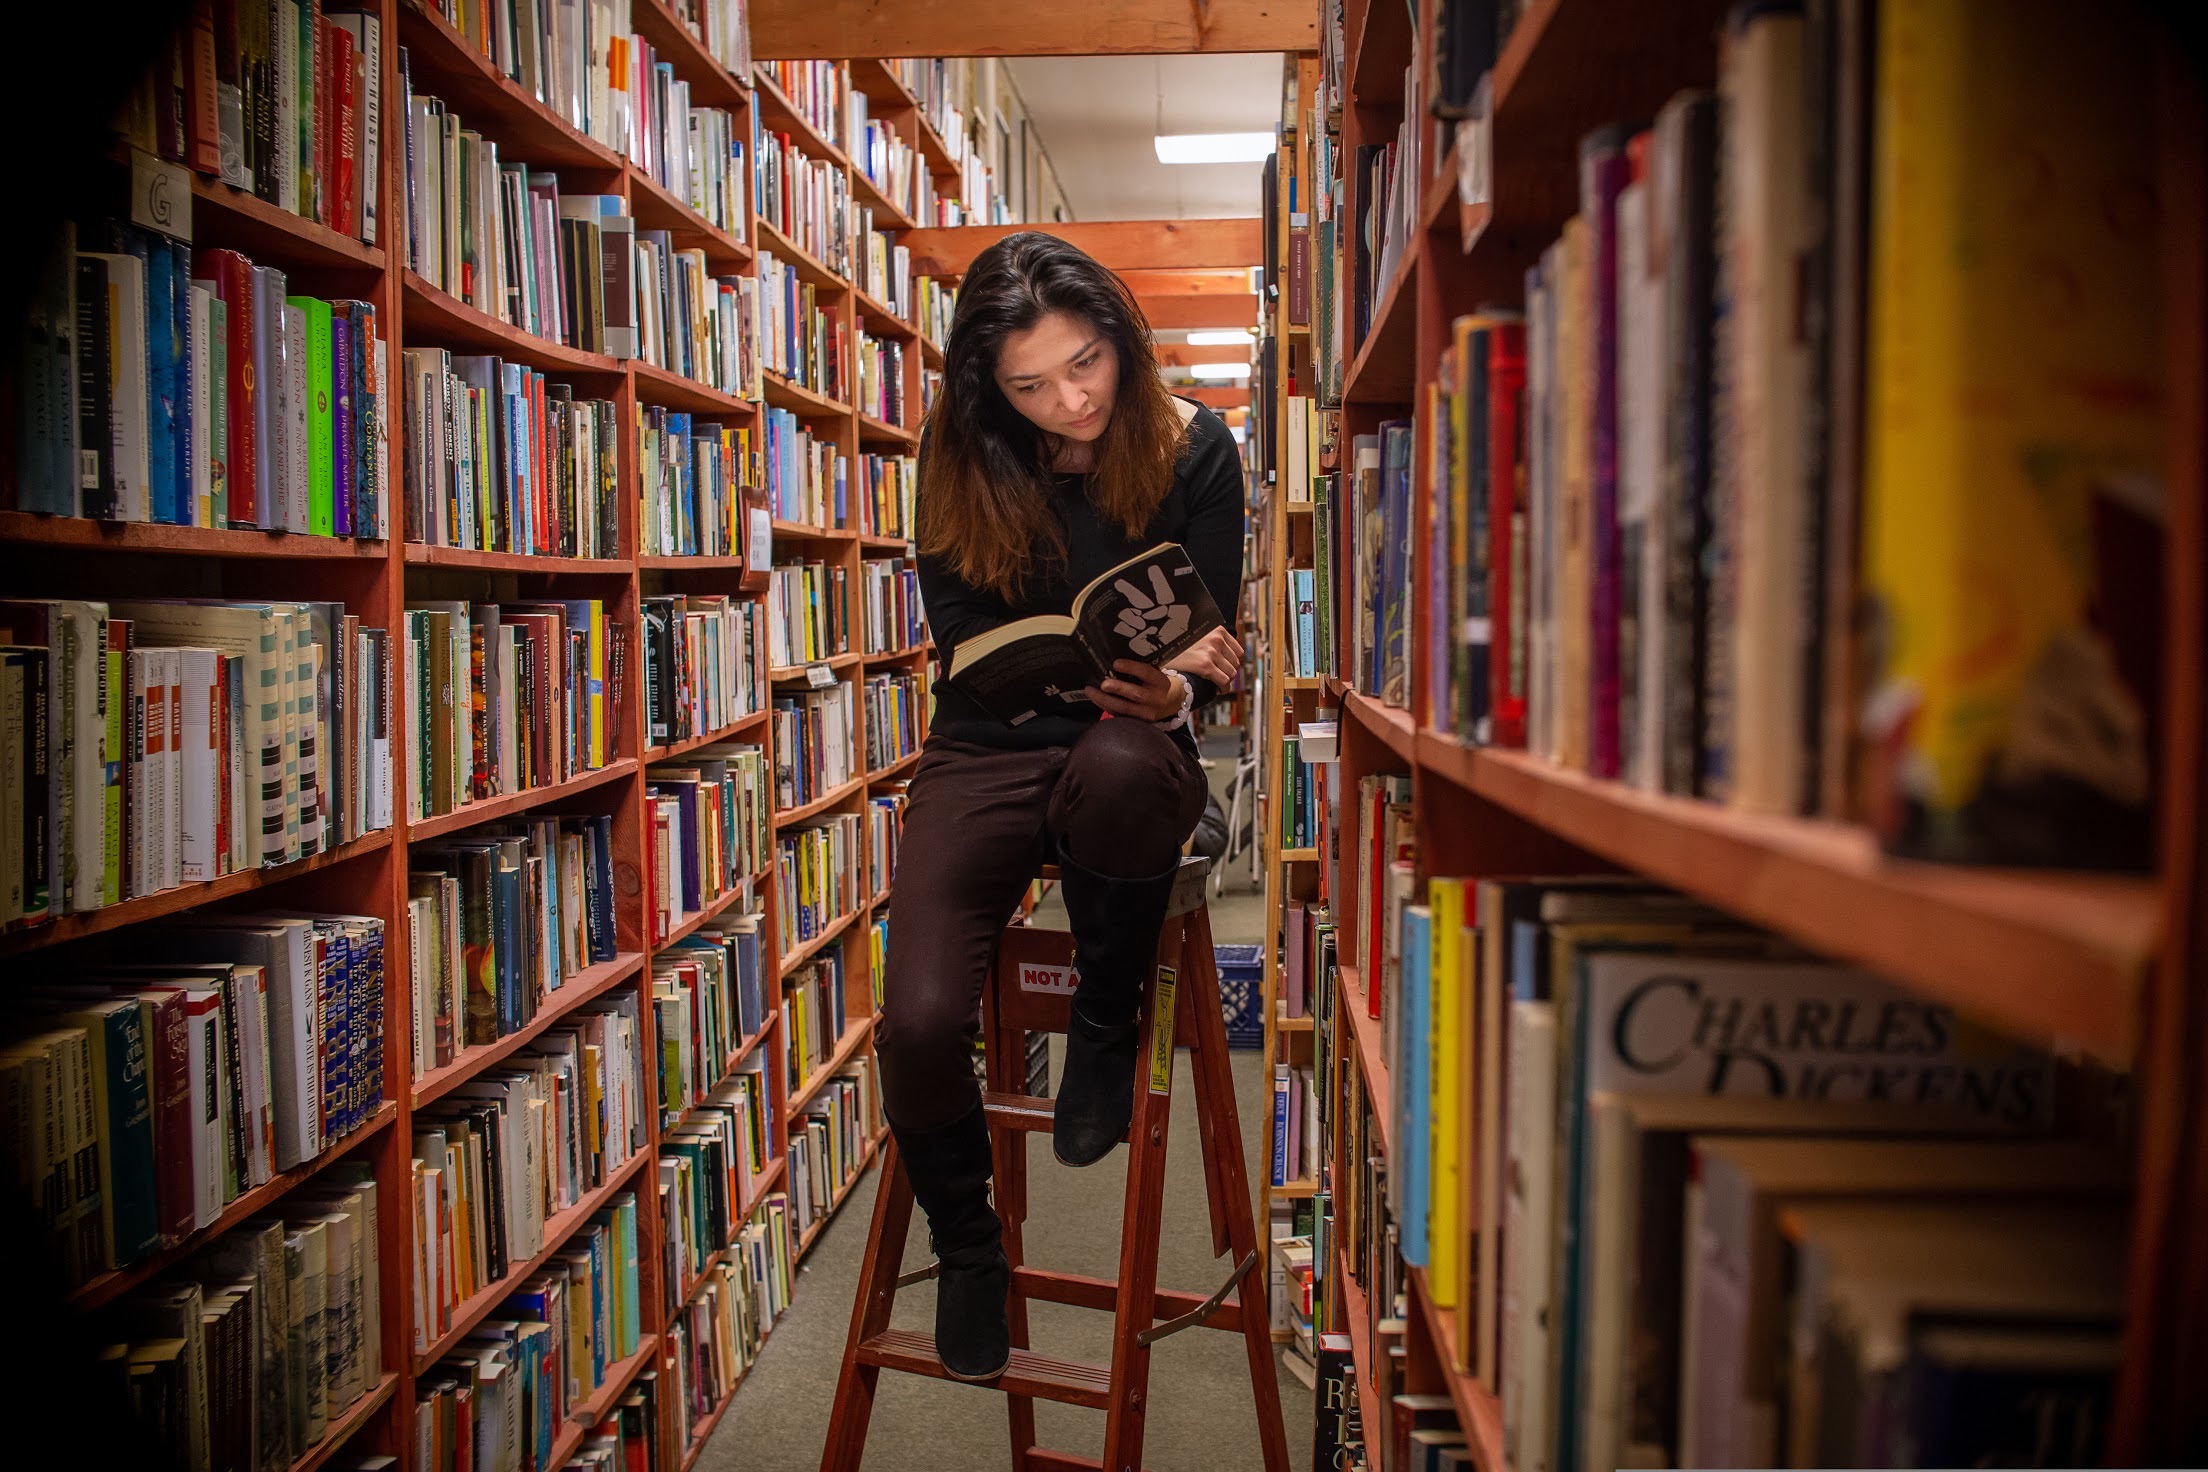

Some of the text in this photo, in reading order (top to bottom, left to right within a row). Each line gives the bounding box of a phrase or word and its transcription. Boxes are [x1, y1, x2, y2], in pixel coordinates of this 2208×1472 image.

[368, 88, 377, 146] HOUSE
[150, 173, 171, 227] G
[240, 265, 248, 348] GABALDON
[274, 301, 282, 388] GABALDON
[338, 327, 347, 389] GABALDON
[322, 434, 327, 450] AN
[365, 411, 374, 495] COMPANION
[98, 629, 107, 710] METROPOLIS
[66, 636, 75, 757] the folded world
[127, 650, 135, 742] RESURRECTION
[461, 667, 472, 736] Sunnyside
[235, 727, 240, 735] on
[7, 747, 15, 789] OWN
[303, 929, 312, 968] ERNEST
[413, 959, 417, 968] OF
[305, 979, 313, 1009] GANN
[318, 961, 326, 998] EXTRA
[1024, 969, 1079, 987] NOT A
[1612, 973, 1956, 1075] CHARLES
[306, 1038, 314, 1062] FATE
[307, 1064, 314, 1074] IS
[307, 1076, 315, 1097] THE
[1706, 1046, 2044, 1122] DICKENS
[84, 1089, 93, 1136] WAITING
[308, 1098, 316, 1139] HUNTER
[46, 1122, 54, 1167] MONKEY
[1276, 1121, 1284, 1153] ROBINSON
[1274, 1154, 1284, 1179] CRUSOE
